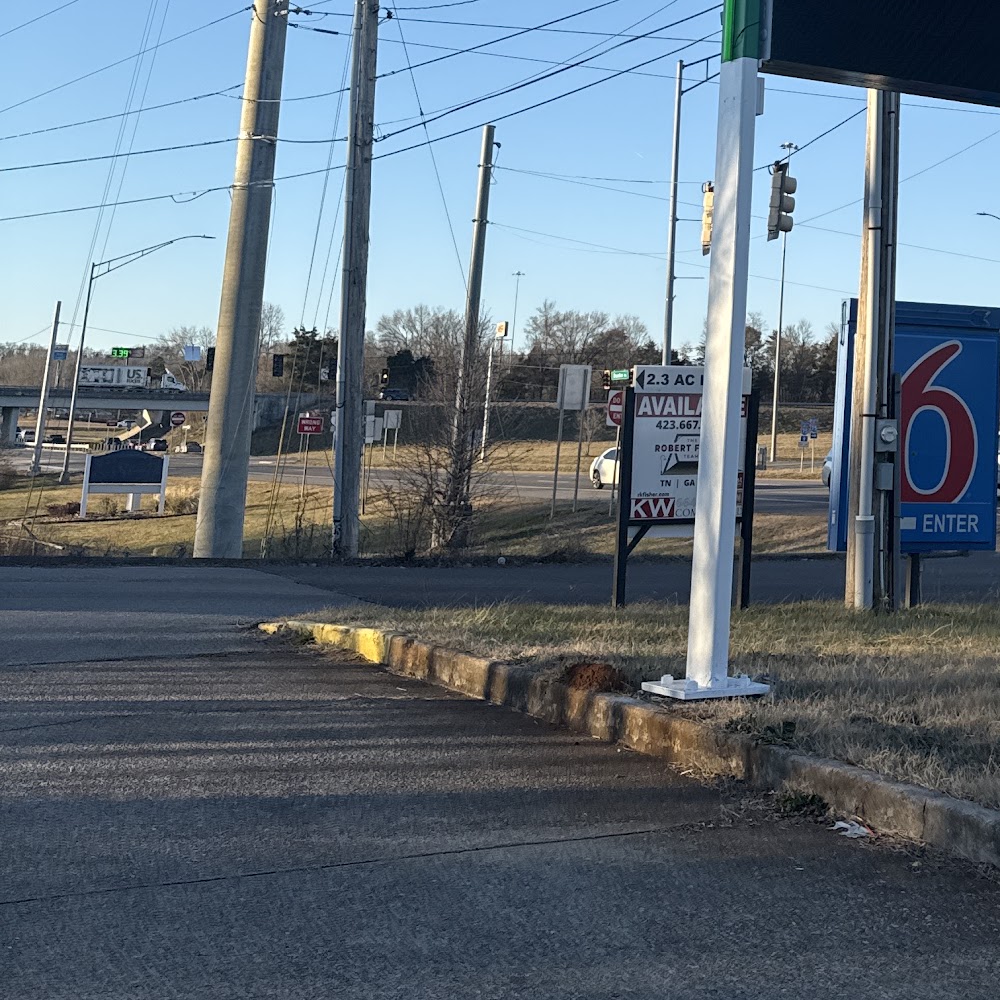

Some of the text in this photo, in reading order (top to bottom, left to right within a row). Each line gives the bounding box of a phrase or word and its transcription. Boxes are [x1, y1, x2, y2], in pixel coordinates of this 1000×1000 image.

[646, 374, 695, 386] 2.3 AC
[655, 421, 701, 430] 423.667.
[900, 339, 979, 504] 6
[655, 444, 692, 452] ROBERT
[660, 479, 695, 487] TN GA
[631, 499, 675, 519] KW
[922, 513, 980, 533] ENTER
